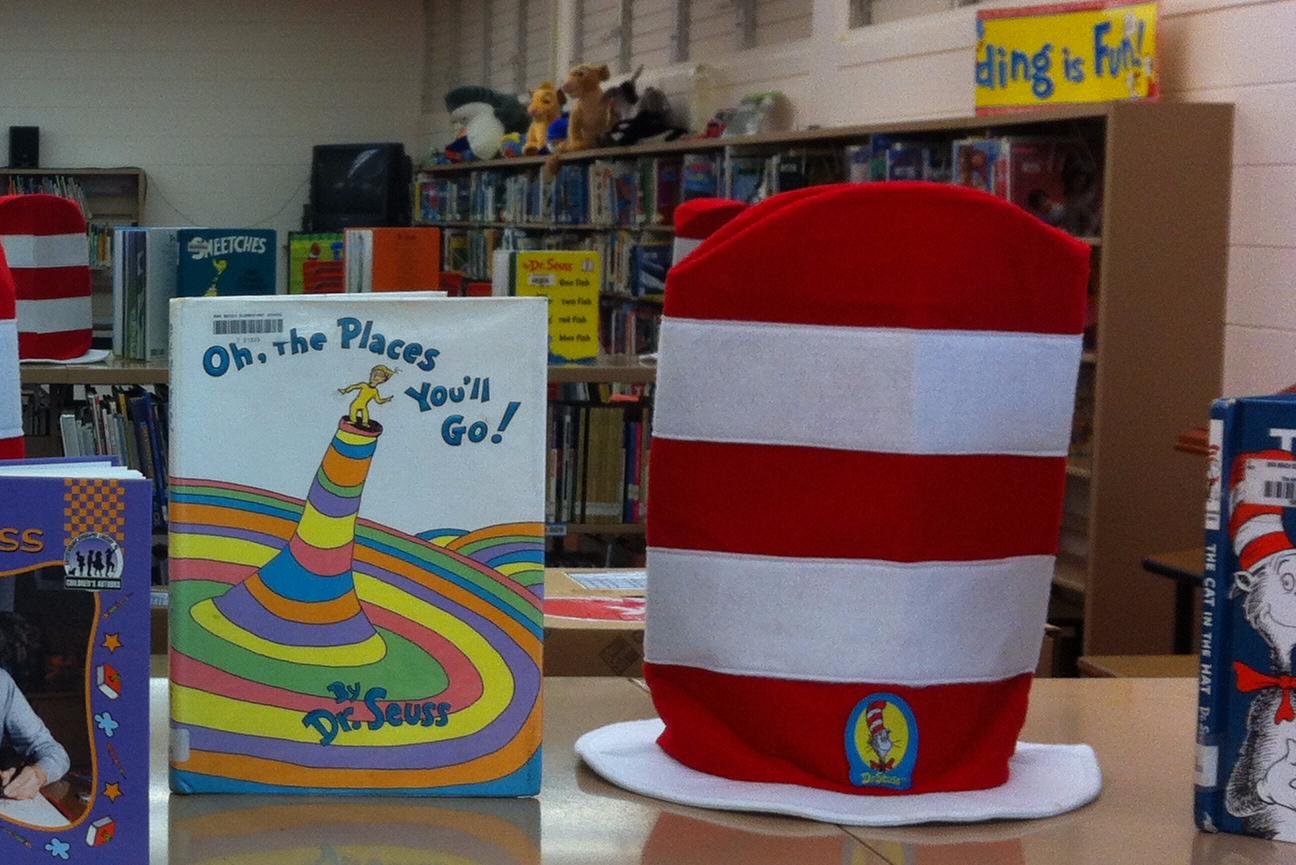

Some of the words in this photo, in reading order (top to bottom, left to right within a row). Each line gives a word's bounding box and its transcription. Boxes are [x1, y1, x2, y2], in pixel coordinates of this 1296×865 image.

[1063, 47, 1085, 83] is
[1093, 21, 1145, 77] Fun!
[188, 235, 267, 260] SNEETCHES
[203, 342, 267, 378] Oh,
[337, 317, 441, 372] Places
[404, 375, 491, 413] You'll
[441, 401, 521, 446] Go!
[1205, 543, 1217, 572] THE
[1204, 577, 1216, 607] CAT
[1203, 611, 1213, 627] IN
[1201, 632, 1212, 658] THE
[1200, 663, 1213, 695] HAT
[301, 707, 361, 747] Dr.
[364, 686, 452, 731] Seuss
